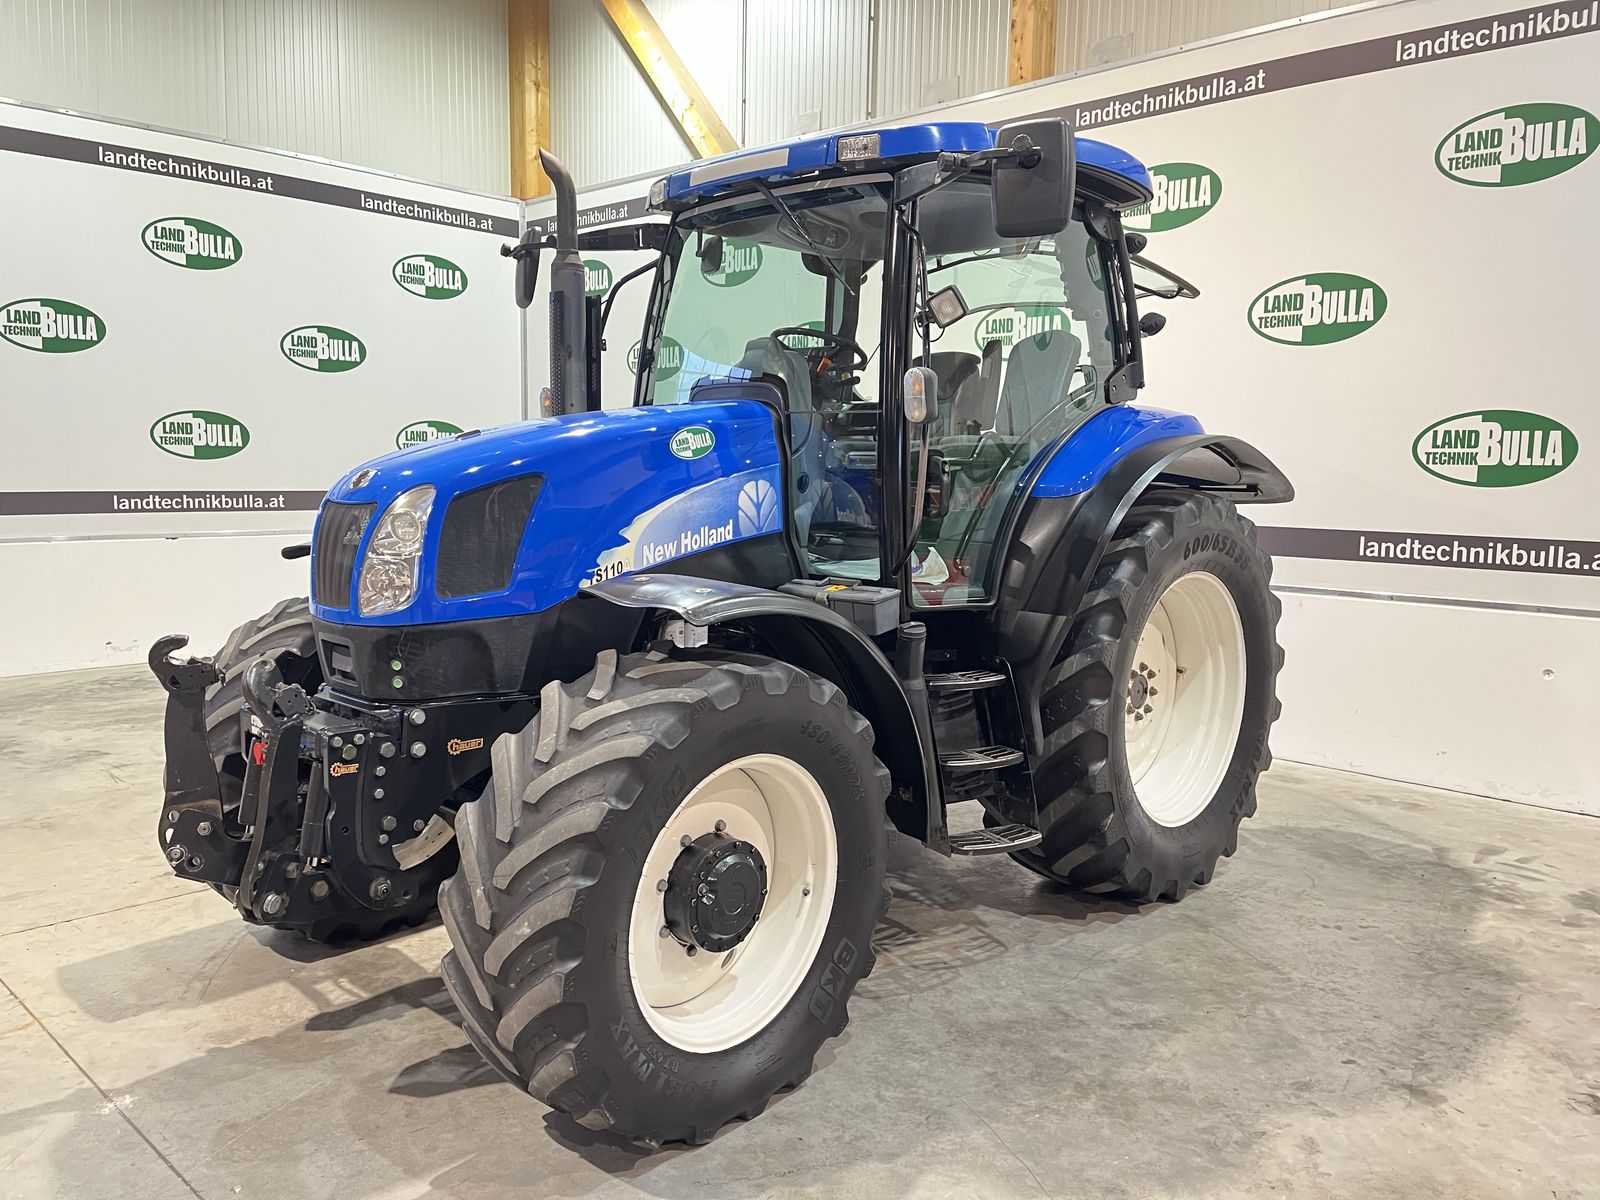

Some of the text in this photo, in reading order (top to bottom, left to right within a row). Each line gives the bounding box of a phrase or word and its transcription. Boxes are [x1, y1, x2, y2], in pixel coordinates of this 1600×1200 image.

[1075, 69, 1266, 127] landtechnikbulla.at
[1454, 128, 1503, 154] LAND
[1501, 117, 1587, 165] BULLA
[98, 146, 274, 191] landtechnikbulla.at
[1448, 151, 1502, 172] TECHNIK
[1151, 174, 1212, 214] BULLA
[360, 194, 494, 231] landtechnikbulla.at
[1120, 202, 1151, 218] ECHNIK
[153, 225, 185, 243] LAND
[184, 225, 235, 260] BULLA
[150, 240, 186, 254] TECHNIK
[402, 262, 425, 277] LAND
[725, 245, 758, 274] BULLA
[399, 274, 425, 286] TECHNIK
[425, 261, 462, 291] BULLA
[584, 266, 609, 292] BULLA
[1263, 293, 1304, 314] LAND
[1302, 284, 1374, 326] BULLA
[6, 309, 41, 325] LAND
[40, 306, 98, 341] BULLA
[985, 318, 1013, 335] LAND
[1258, 313, 1303, 329] TECHNIK
[2, 325, 42, 337] TECHNIK
[291, 334, 317, 349] LAND
[288, 347, 318, 359] TECHNIK
[317, 332, 360, 362] BULLA
[162, 421, 193, 436] LAND
[193, 418, 243, 448] BULLA
[405, 430, 428, 442] LAND
[158, 434, 194, 447] TECHNIK
[675, 437, 689, 447] LAND
[689, 432, 712, 450] BULLA
[1431, 429, 1480, 450] LAND
[1477, 421, 1563, 467] BULLA
[1425, 451, 1478, 466] TECHNIK
[113, 494, 285, 510] landtechnikbulla.at
[641, 519, 733, 566] New Holland
